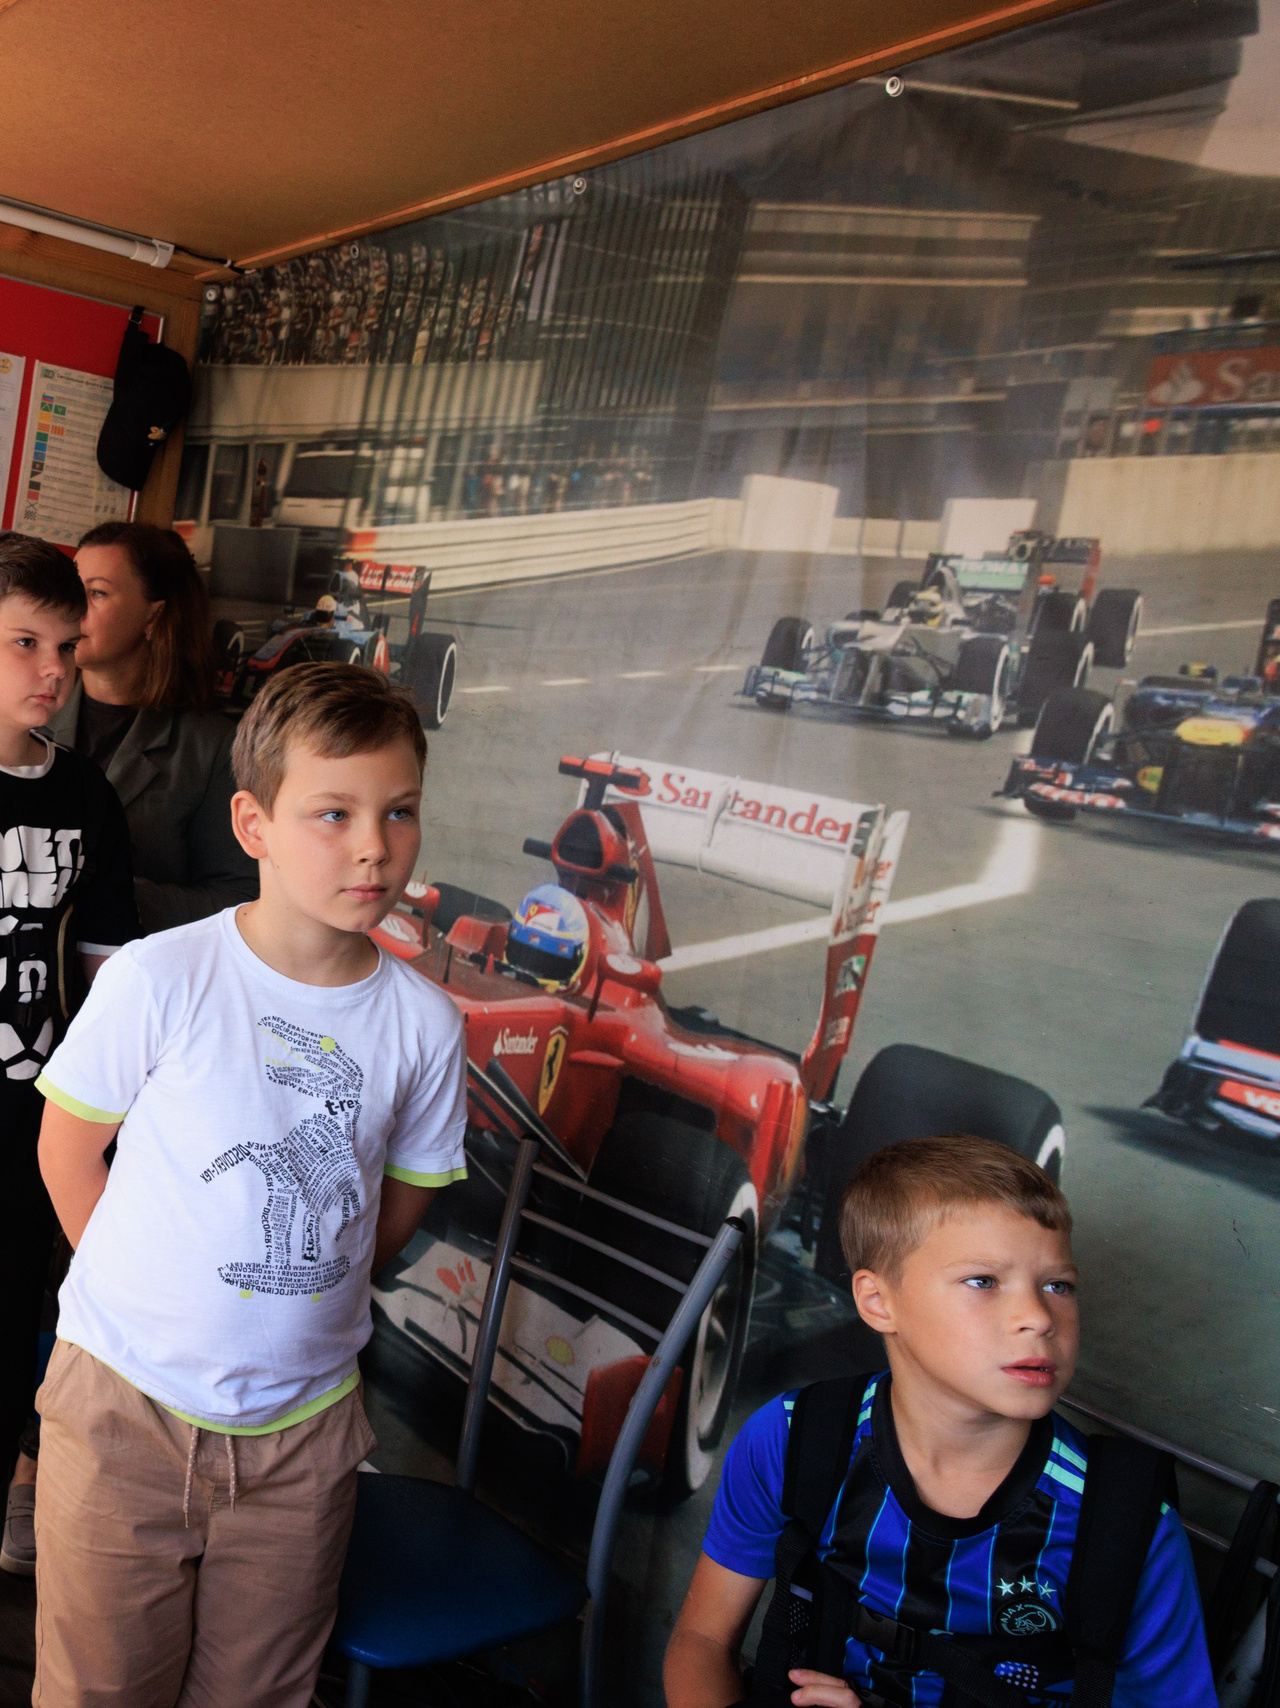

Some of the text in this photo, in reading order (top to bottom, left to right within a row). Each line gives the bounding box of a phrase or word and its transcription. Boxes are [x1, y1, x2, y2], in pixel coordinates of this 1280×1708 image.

[264, 1022, 310, 1041] VELOCIRAPTOR
[272, 1016, 287, 1025] NEW
[288, 1023, 300, 1032] ERA
[301, 1028, 318, 1038] t-rex
[271, 1028, 307, 1047] DISCOVER
[278, 1078, 297, 1088] NEW
[298, 1087, 313, 1097] ERA
[325, 1099, 360, 1116] t-rex
[1000, 1603, 1025, 1624] AJAX
